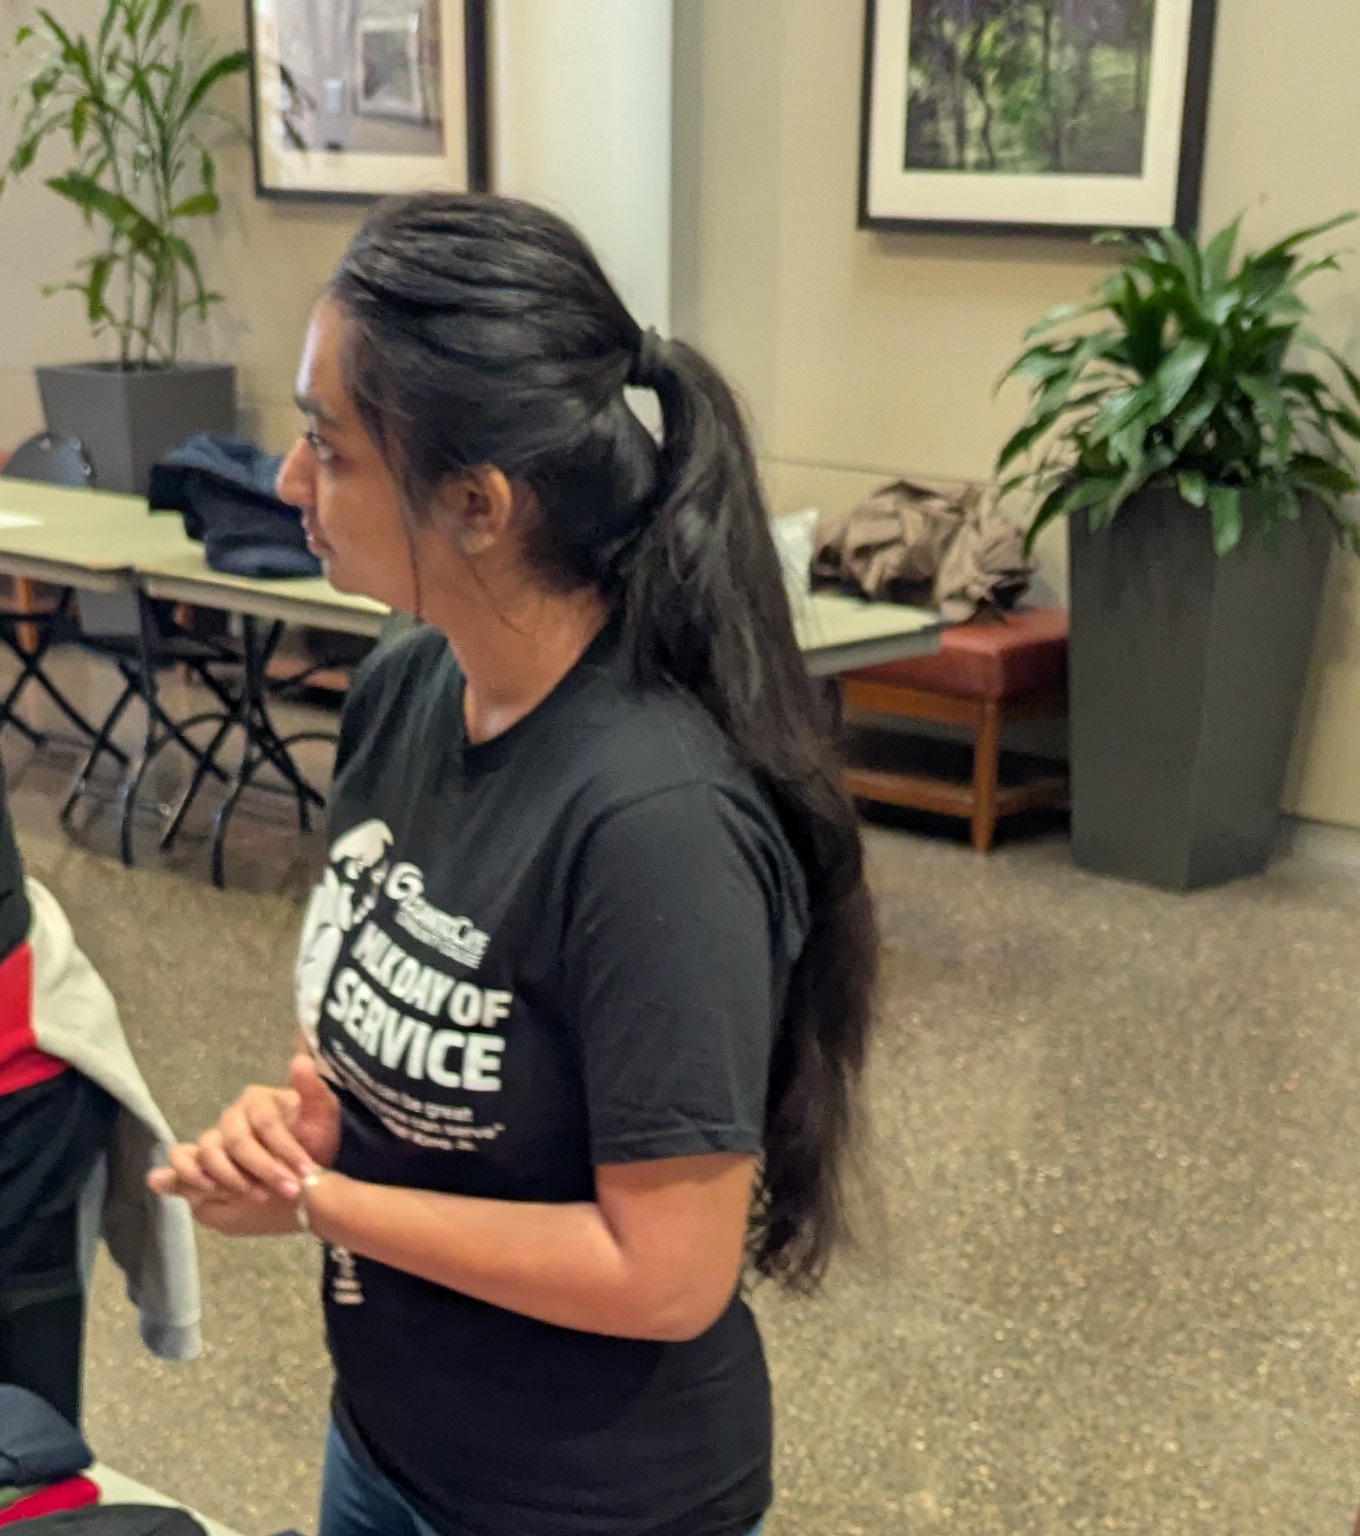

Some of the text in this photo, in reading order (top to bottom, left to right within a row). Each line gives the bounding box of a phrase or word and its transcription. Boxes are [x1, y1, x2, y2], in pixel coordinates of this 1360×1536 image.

[324, 965, 507, 1093] SERVICE
[390, 955, 456, 1017] DAY
[447, 980, 514, 1028] OF
